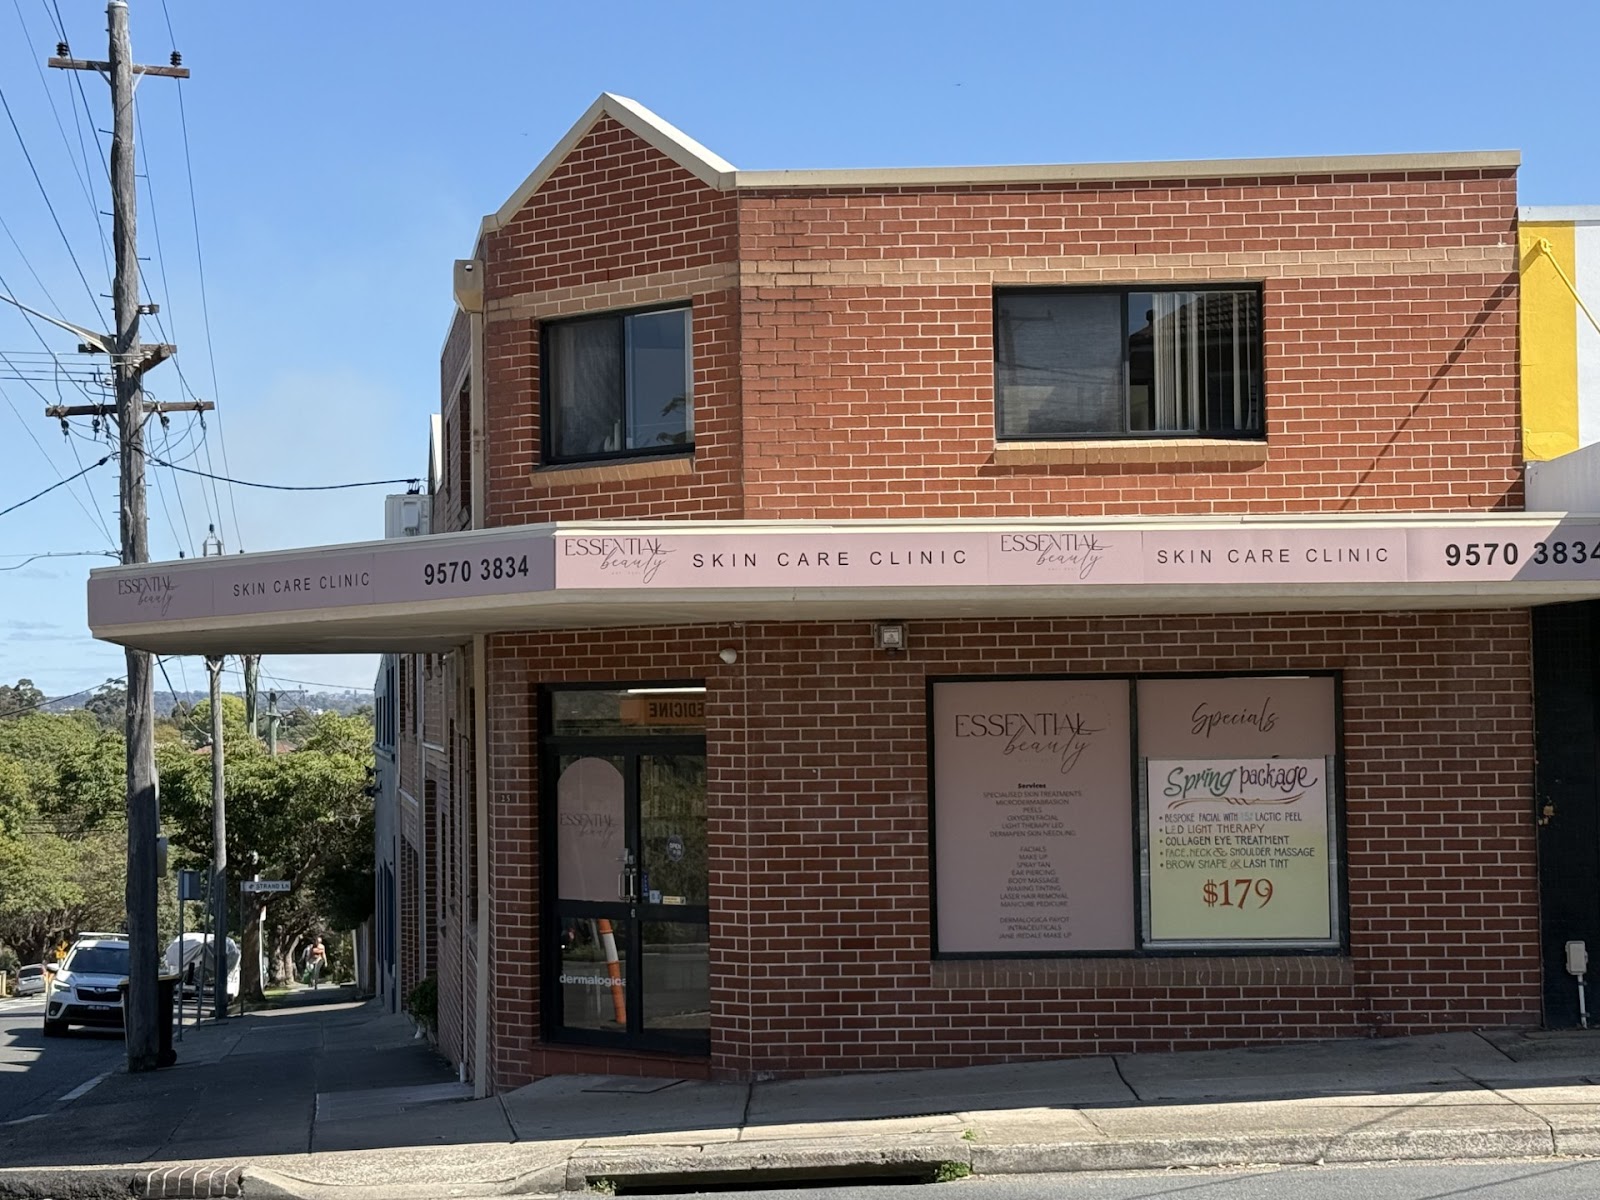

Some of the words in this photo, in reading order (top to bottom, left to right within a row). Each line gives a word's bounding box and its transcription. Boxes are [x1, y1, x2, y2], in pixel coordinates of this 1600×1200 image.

[565, 537, 668, 556] ESSENTIAL
[1001, 533, 1104, 552] ESSENTIAL
[1445, 542, 1519, 567] 9570
[1533, 541, 1600, 565] 3834
[600, 544, 676, 584] beauty
[692, 553, 757, 568] SKIN
[777, 552, 849, 566] CARE
[869, 550, 967, 565] CLINIC
[1036, 541, 1113, 580] beauty
[1157, 549, 1212, 564] SKIN
[1227, 548, 1290, 563] CARE
[1305, 547, 1388, 563] CLINIC
[424, 560, 471, 586] 9570
[480, 554, 529, 581] 3834
[118, 575, 176, 596] ESSENTIAL
[233, 582, 265, 597] SKIN
[273, 577, 311, 593] CARE
[319, 572, 370, 589] CLINIC
[138, 582, 179, 617] beauty
[955, 712, 1093, 738] ESSENTIAL
[1191, 696, 1279, 739] Specials
[1003, 721, 1105, 774] beauty
[1163, 766, 1237, 799] Spring
[1240, 763, 1318, 794] package
[1164, 812, 1195, 823] BESPOKE
[1198, 812, 1221, 822] FACIAL
[1223, 812, 1238, 822] WITH
[1254, 812, 1282, 822] LACTIC
[1284, 812, 1303, 821] PEEL
[1165, 824, 1184, 834] LED
[1187, 824, 1212, 834] LIGHT
[1216, 823, 1265, 833] THERAPY
[1165, 836, 1211, 846] COLLAGEN
[1214, 836, 1232, 846] EYE
[1234, 835, 1290, 845] TREATMENT
[1229, 847, 1271, 857] SHOULDER
[1273, 847, 1315, 857] MASSAGE
[1165, 859, 1196, 869] BROW
[1198, 859, 1227, 869] SHAPE
[1243, 858, 1267, 868] LASH
[1269, 858, 1290, 868] TINT
[1203, 878, 1273, 910] $179
[559, 973, 627, 987] dermalogica
